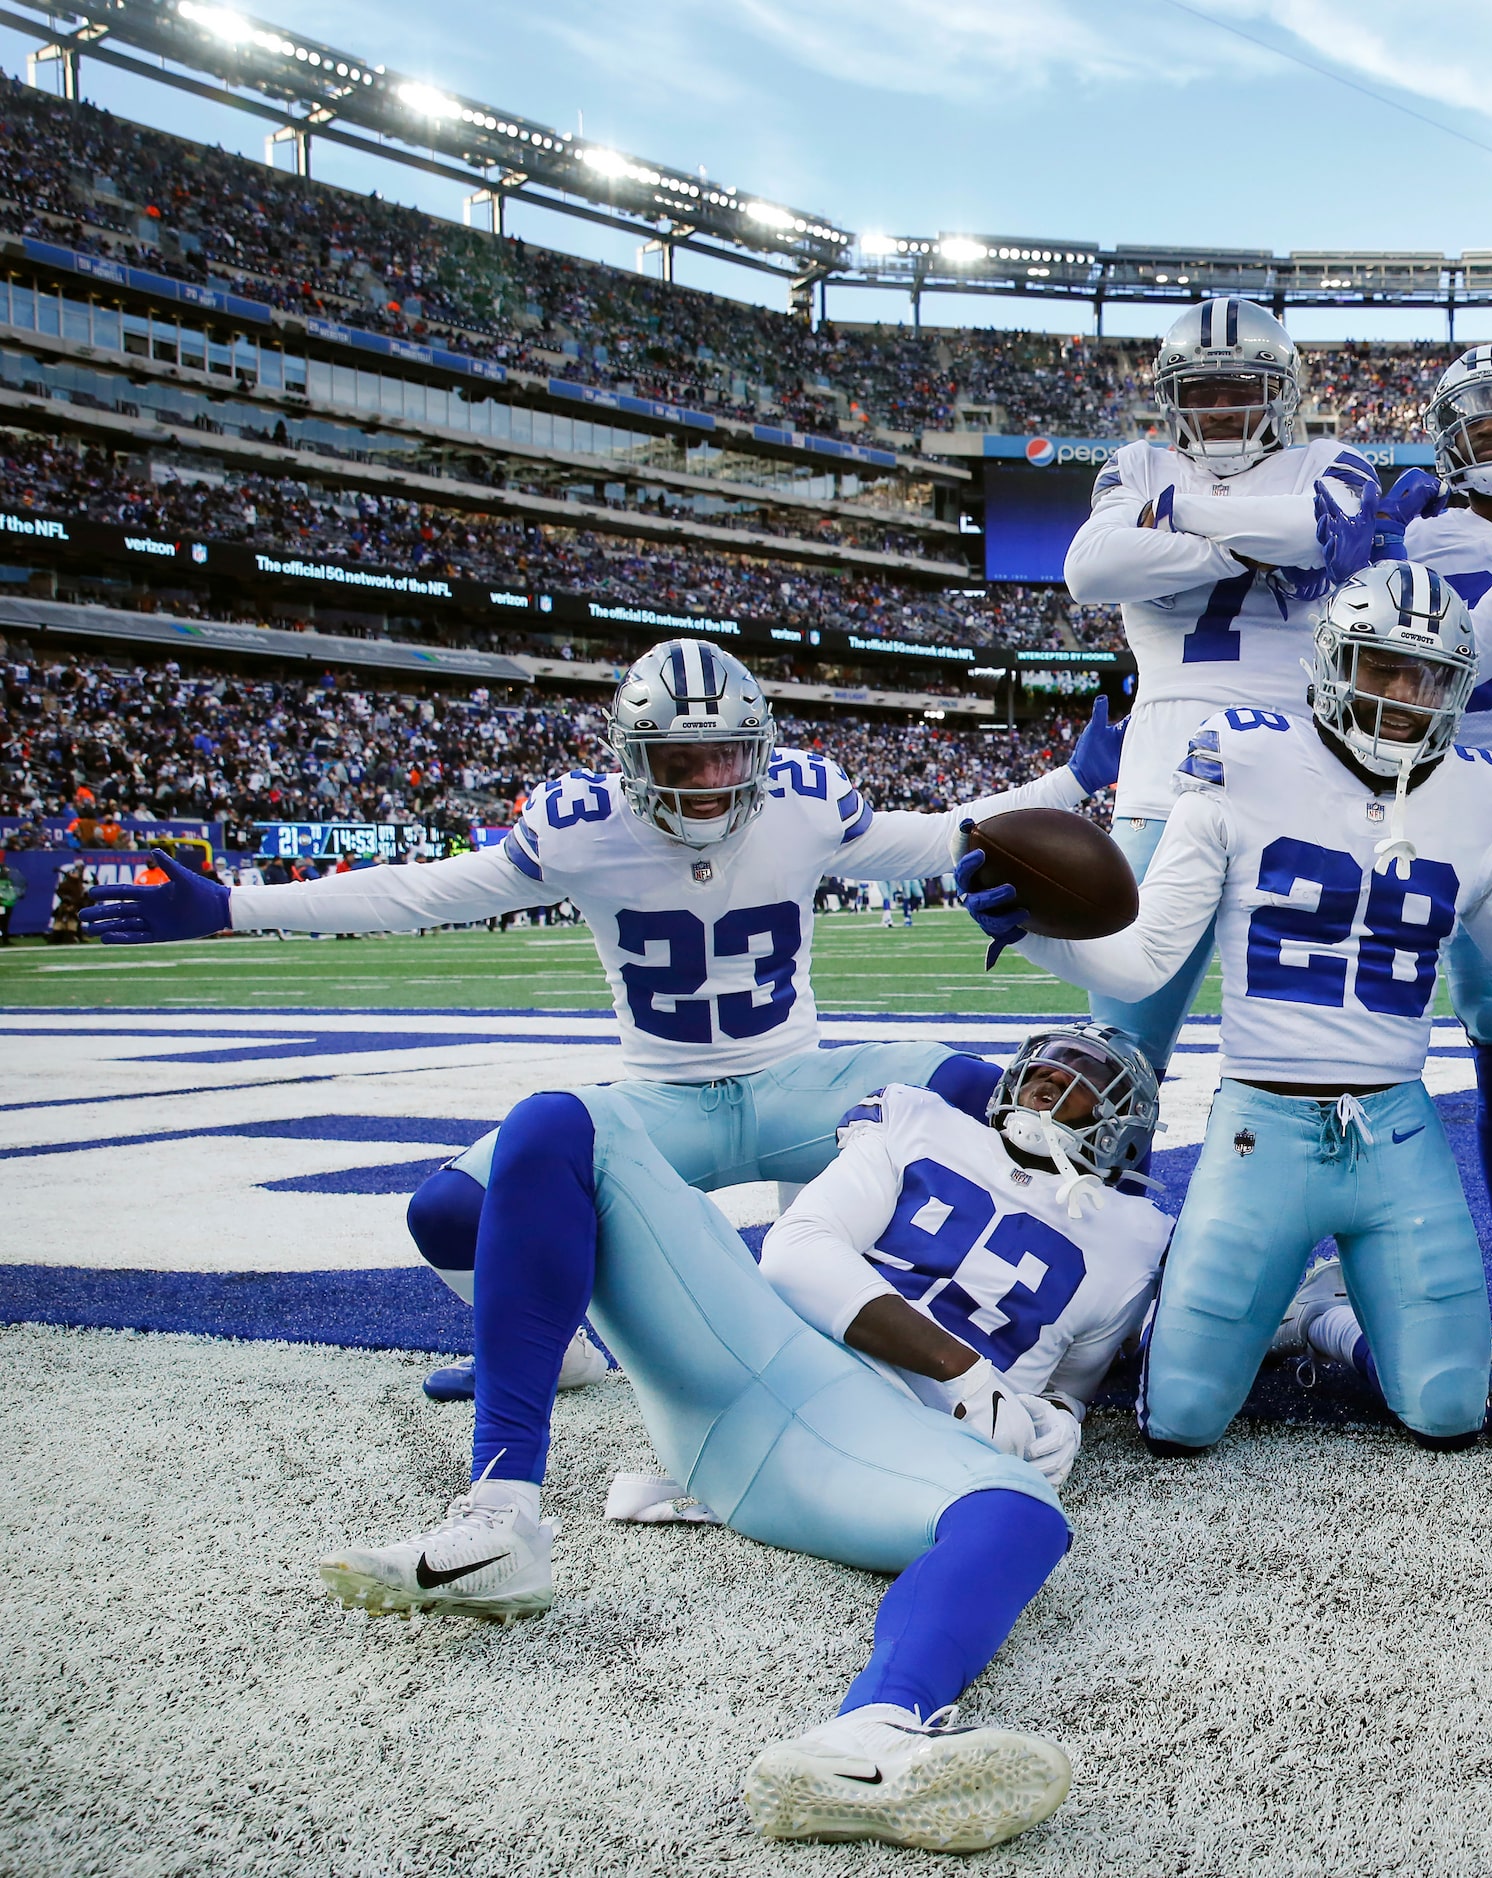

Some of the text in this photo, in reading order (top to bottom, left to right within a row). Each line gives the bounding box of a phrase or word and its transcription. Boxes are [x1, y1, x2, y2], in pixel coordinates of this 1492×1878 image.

[6, 515, 34, 534] the
[125, 537, 176, 557] verizon
[256, 555, 281, 572] The
[282, 561, 324, 579] official
[326, 566, 344, 582] 5G
[346, 571, 394, 590] network
[395, 577, 407, 591] of
[408, 578, 427, 594] the
[490, 592, 528, 607] verizon
[589, 603, 608, 618] The
[609, 606, 641, 623] official
[641, 611, 655, 625] 5G
[656, 614, 694, 629] network
[694, 617, 705, 630] of
[705, 618, 720, 632] the
[1182, 571, 1264, 663] 7
[849, 636, 865, 649] The
[865, 638, 892, 652] official
[893, 640, 905, 653] 5G
[905, 642, 936, 657] network
[937, 646, 946, 657] of
[1400, 631, 1434, 644] COWBOYS
[1017, 652, 1069, 661] INTERCEPTED
[1070, 652, 1081, 661] BY
[682, 721, 717, 729] COWBOYS
[278, 827, 298, 855] 21
[333, 829, 377, 854] 14:53
[378, 826, 396, 841] QTR
[1245, 837, 1460, 1017] 28
[616, 901, 802, 1044] 23
[874, 1157, 1087, 1373] 93
